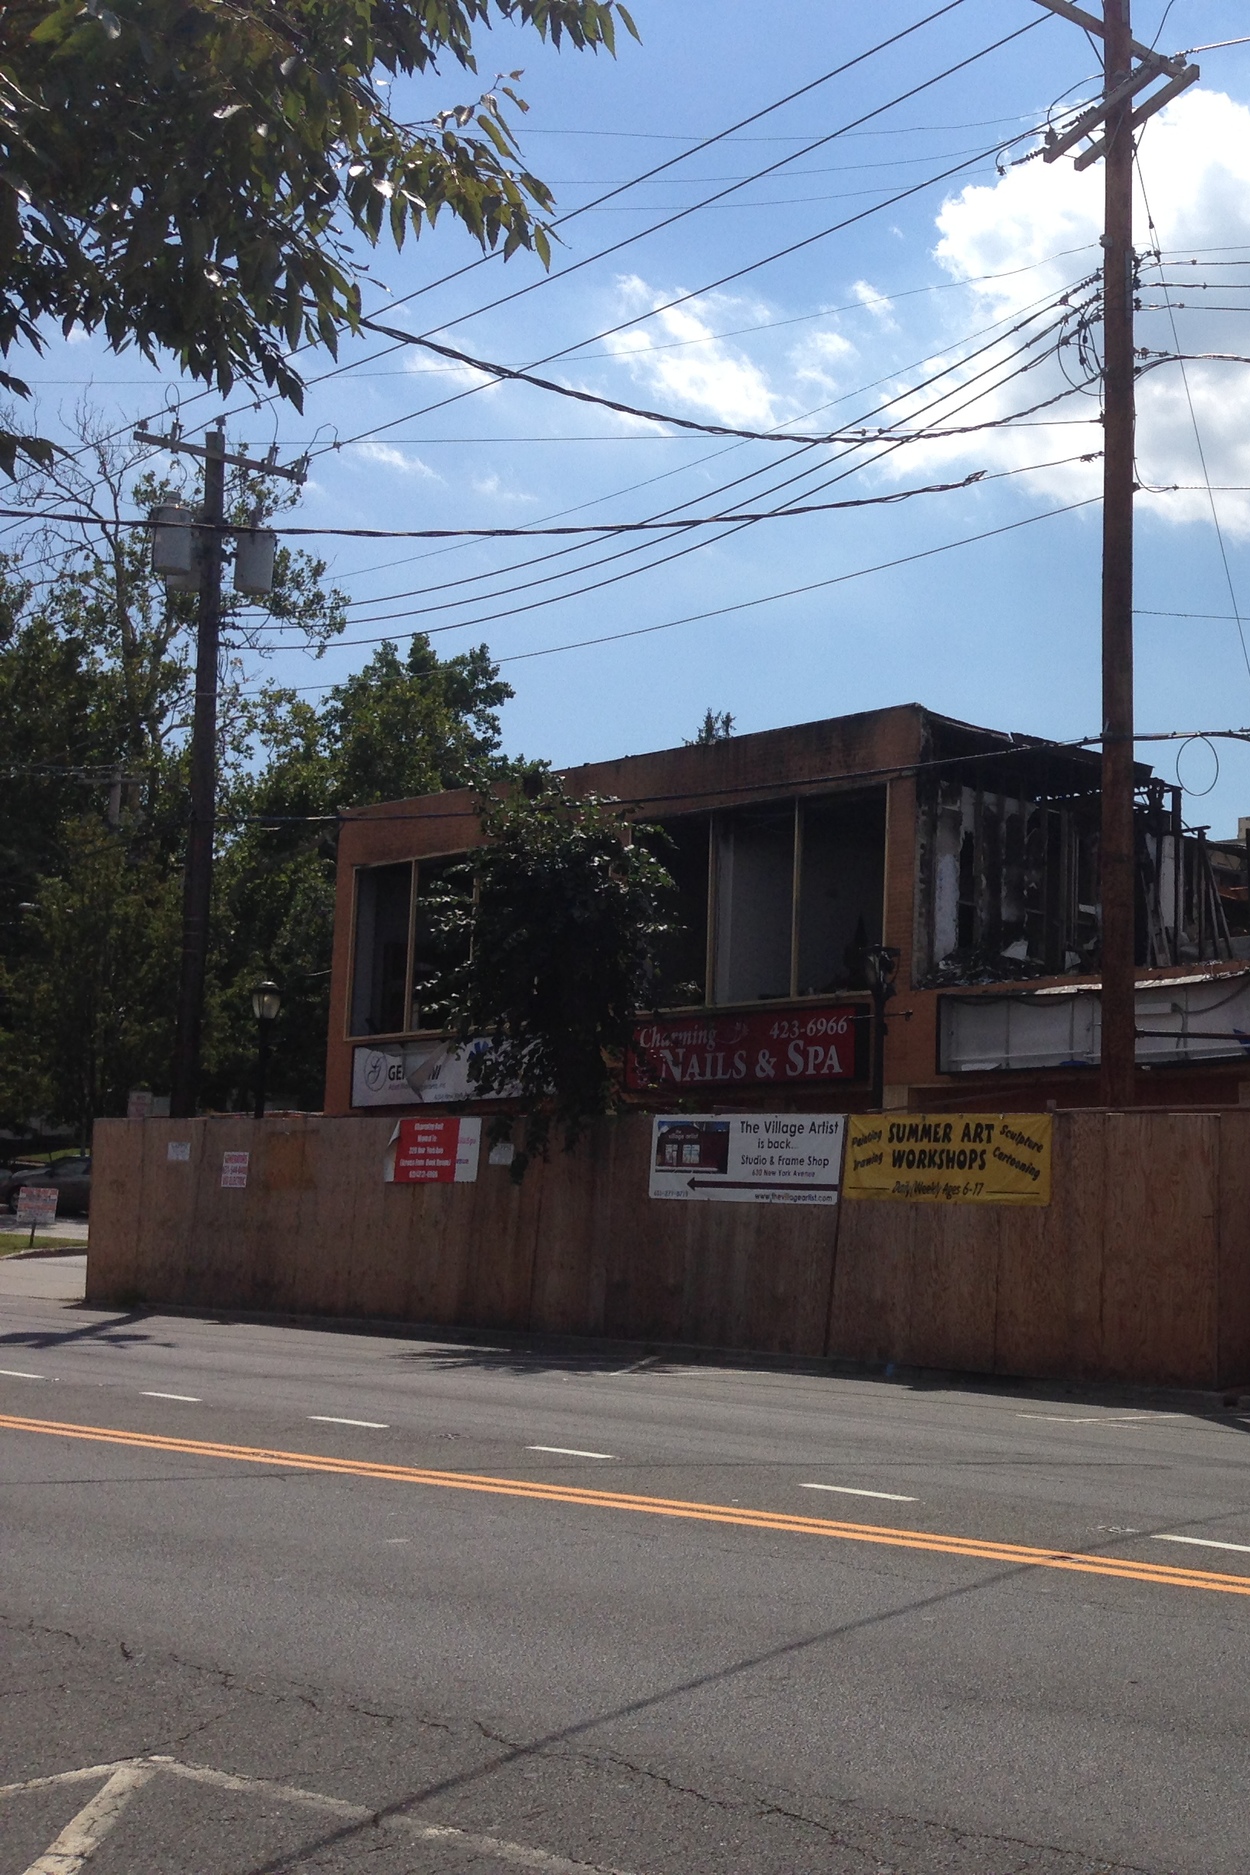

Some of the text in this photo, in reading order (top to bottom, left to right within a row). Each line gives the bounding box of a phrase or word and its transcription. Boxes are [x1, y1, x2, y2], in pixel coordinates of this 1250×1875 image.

[640, 1023, 718, 1051] Charming
[769, 1016, 848, 1040] 423-6966
[754, 1048, 778, 1079] &
[740, 1120, 840, 1138] The Village Artist
[851, 1130, 883, 1148] Painting
[887, 1122, 995, 1144] SUMMER ART
[1000, 1124, 1044, 1154] Sculpture
[758, 1138, 765, 1149] is
[741, 1155, 830, 1168] Studio & Frame Shop
[891, 1149, 987, 1171] WORKSHOPS
[992, 1146, 1041, 1181] Cartooning
[763, 1169, 776, 1177] New
[778, 1169, 791, 1177] York
[793, 1170, 816, 1178] Avenue
[755, 1192, 833, 1203] www.thevillageartist.com
[942, 1181, 960, 1199] Ages
[962, 1181, 984, 1196] 6-17
